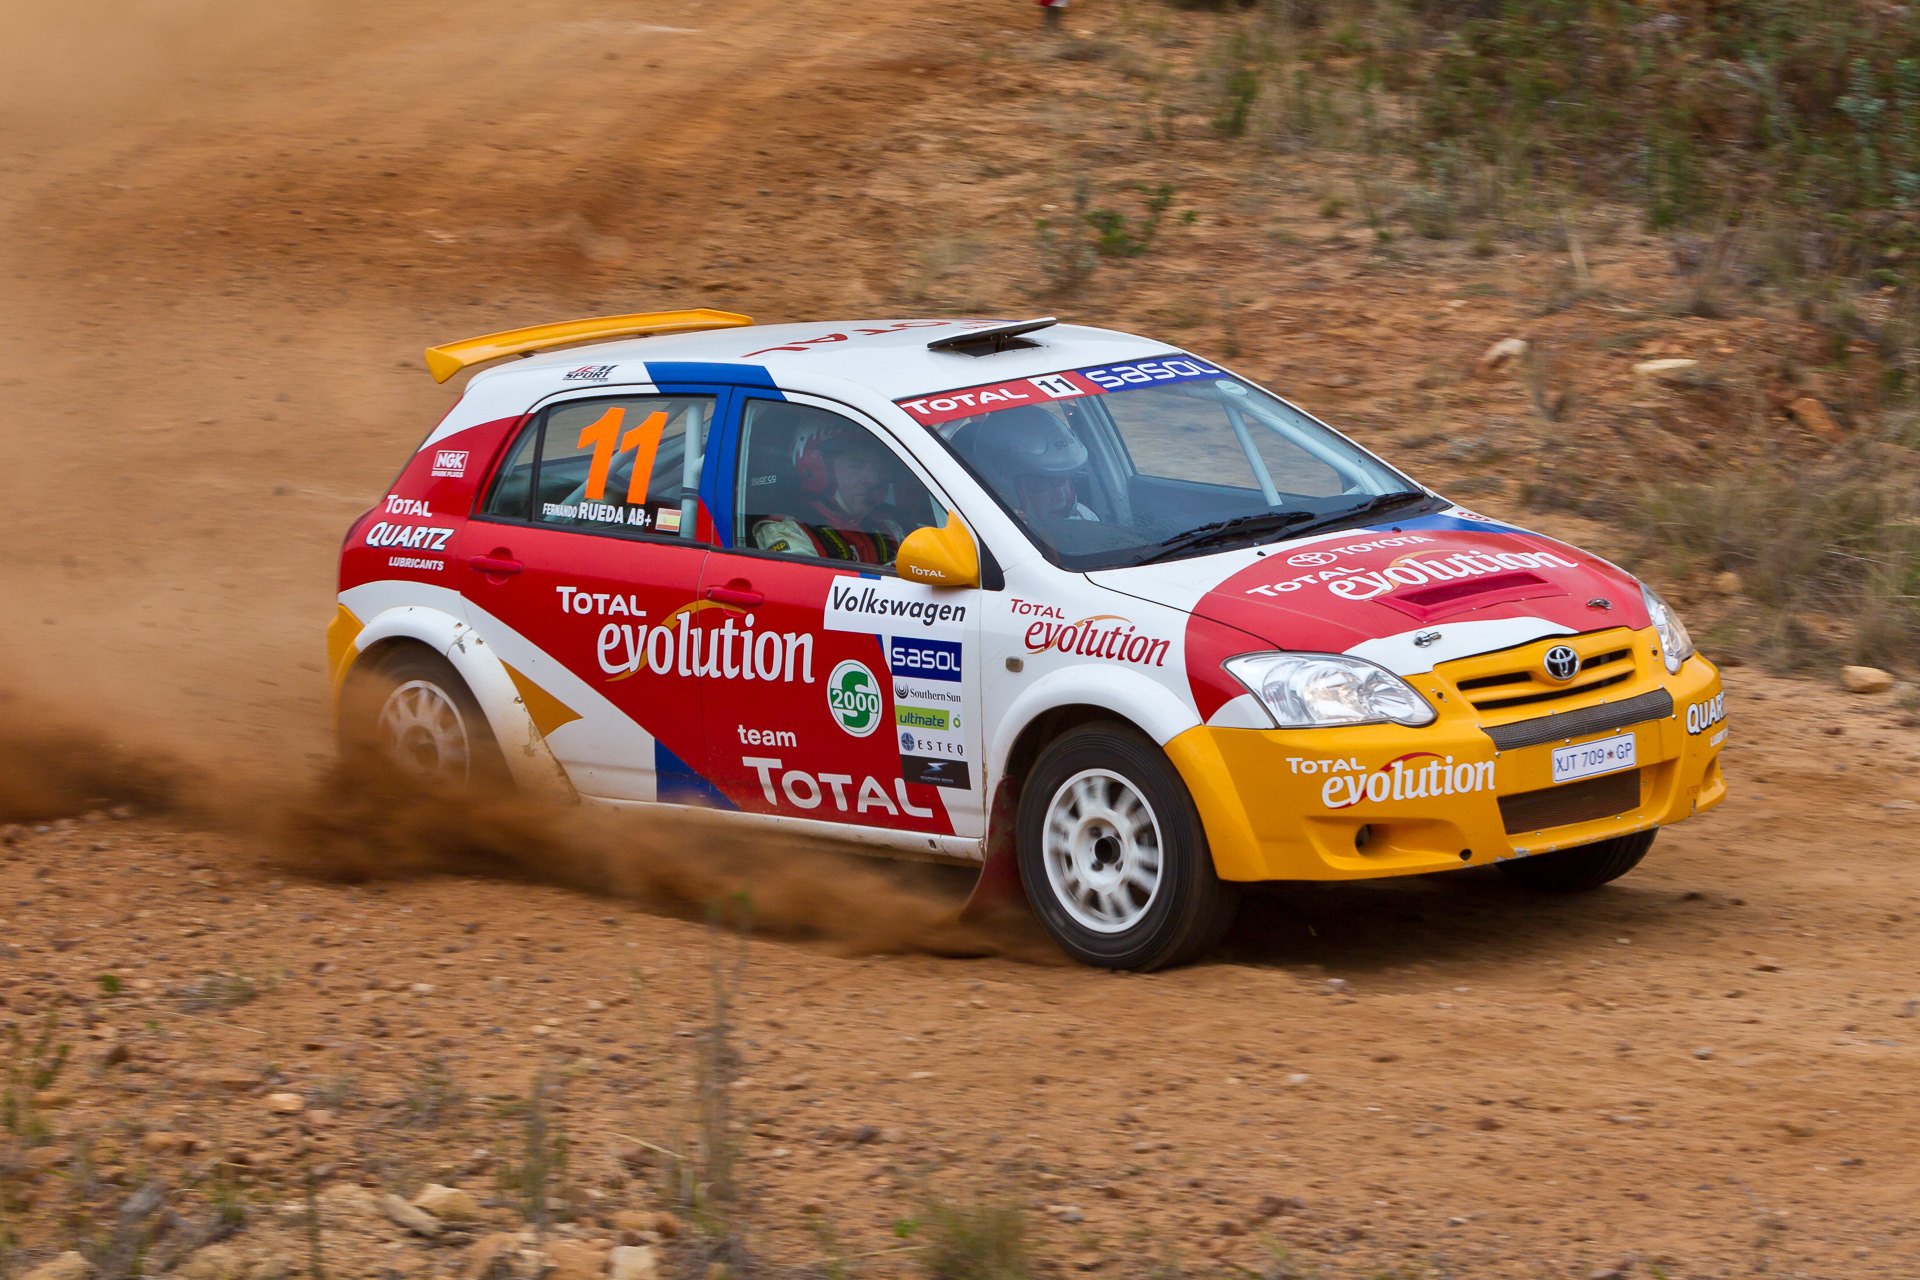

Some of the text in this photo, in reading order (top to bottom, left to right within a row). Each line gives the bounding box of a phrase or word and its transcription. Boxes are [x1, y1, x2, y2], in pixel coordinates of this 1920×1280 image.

[565, 371, 609, 379] SPORT
[900, 388, 1029, 416] TOTAL
[1037, 377, 1076, 395] 11
[435, 452, 466, 469] NGK
[576, 407, 668, 505] 11
[385, 494, 433, 518] TOTAL
[542, 502, 652, 527] FERNANDO RUEDA AB+
[365, 521, 455, 551] QUARTZ
[1329, 535, 1436, 556] TOYOTA
[388, 556, 445, 571] LUBRICANTS
[909, 565, 946, 578] TOTAL
[1327, 550, 1580, 601] evolution
[1245, 565, 1366, 597] TOTAL
[556, 586, 647, 616] TOTAL
[833, 586, 966, 626] Volkswagen
[1010, 599, 1065, 619] TOTAL
[597, 613, 815, 683] evolution
[1025, 620, 1171, 667] evolution
[832, 689, 879, 713] 2000
[899, 712, 945, 727] ultimate
[737, 725, 797, 748] team
[917, 739, 964, 756] ESTEQ
[1285, 757, 1366, 775] TOTAL
[1555, 742, 1633, 773] XJT 709 GP
[742, 757, 934, 818] TOTAL
[1321, 755, 1496, 809] evolution
